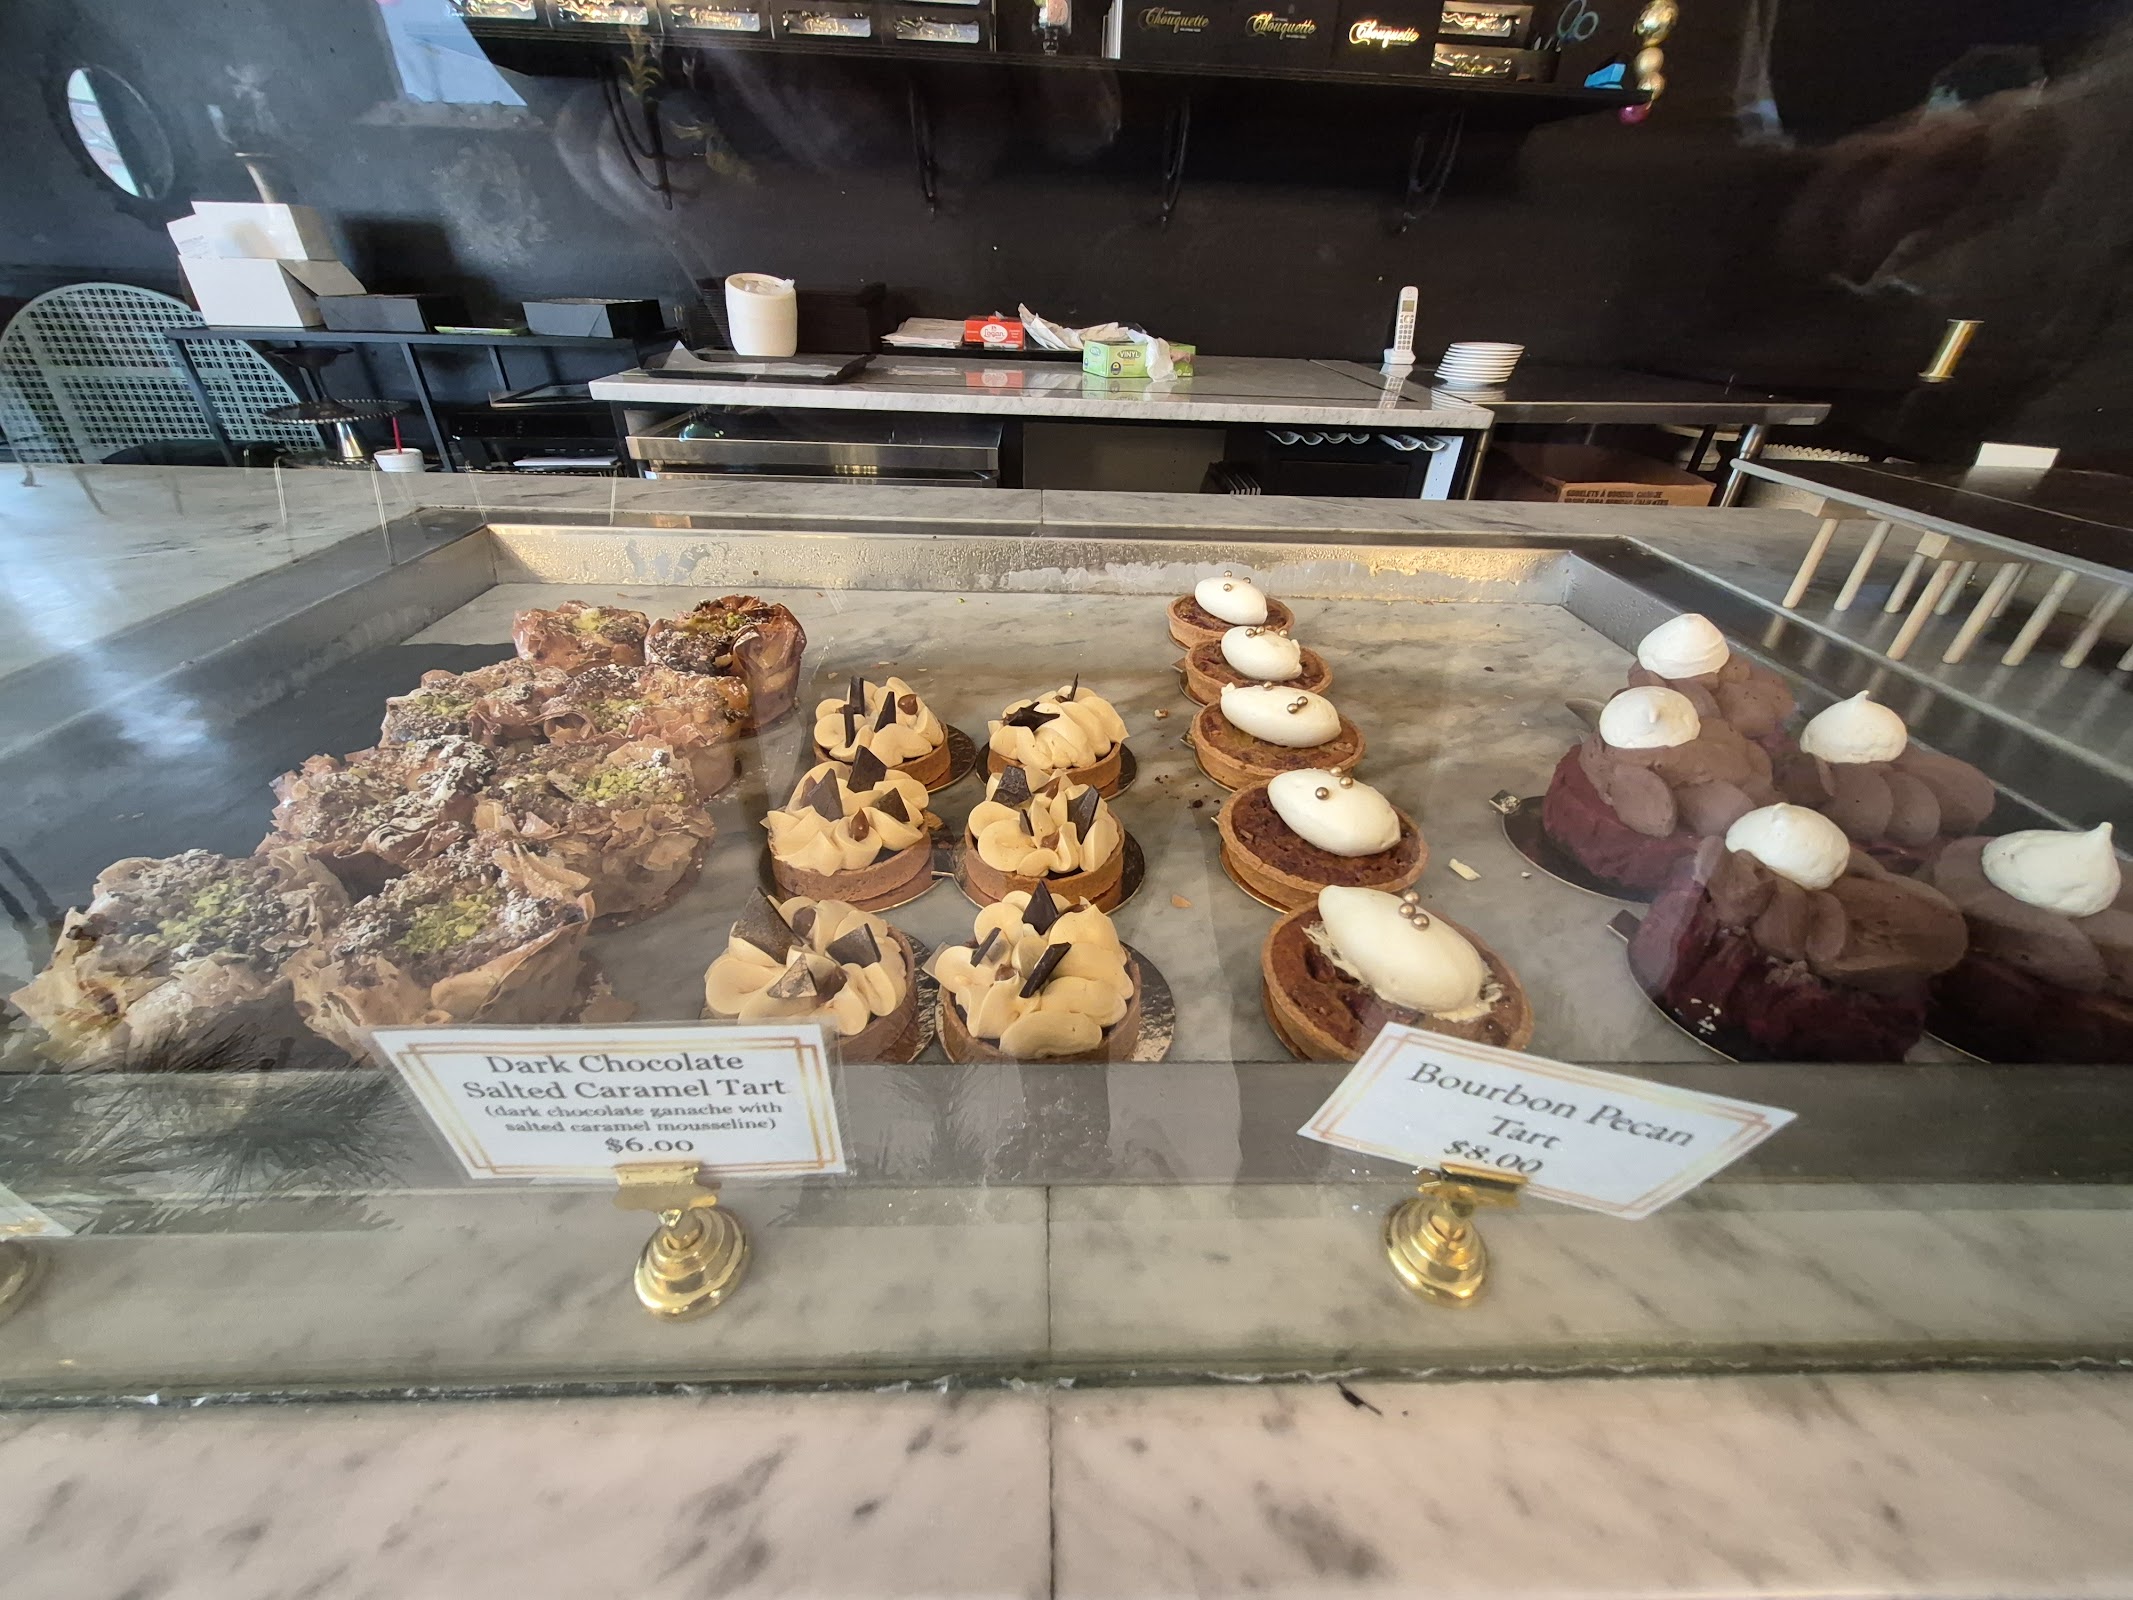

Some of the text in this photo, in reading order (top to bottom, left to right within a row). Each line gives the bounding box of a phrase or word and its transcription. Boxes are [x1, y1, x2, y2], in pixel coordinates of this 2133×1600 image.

[1138, 7, 1209, 33] Chouquette
[1246, 13, 1317, 40] Chouquette
[1349, 20, 1420, 48] Chouquette
[1119, 350, 1140, 358] VINYL
[486, 1053, 745, 1073] Dark Chocolate
[463, 1078, 787, 1099] Salted Caramel Tart
[485, 1102, 783, 1119] (dark chocolate ganache with
[1408, 1062, 1695, 1147] Bourbon Pecan
[505, 1118, 777, 1132] salted caramel mousseline)
[1487, 1114, 1561, 1149] Tart
[605, 1137, 695, 1154] $6.00
[1443, 1139, 1544, 1173] $8.00
